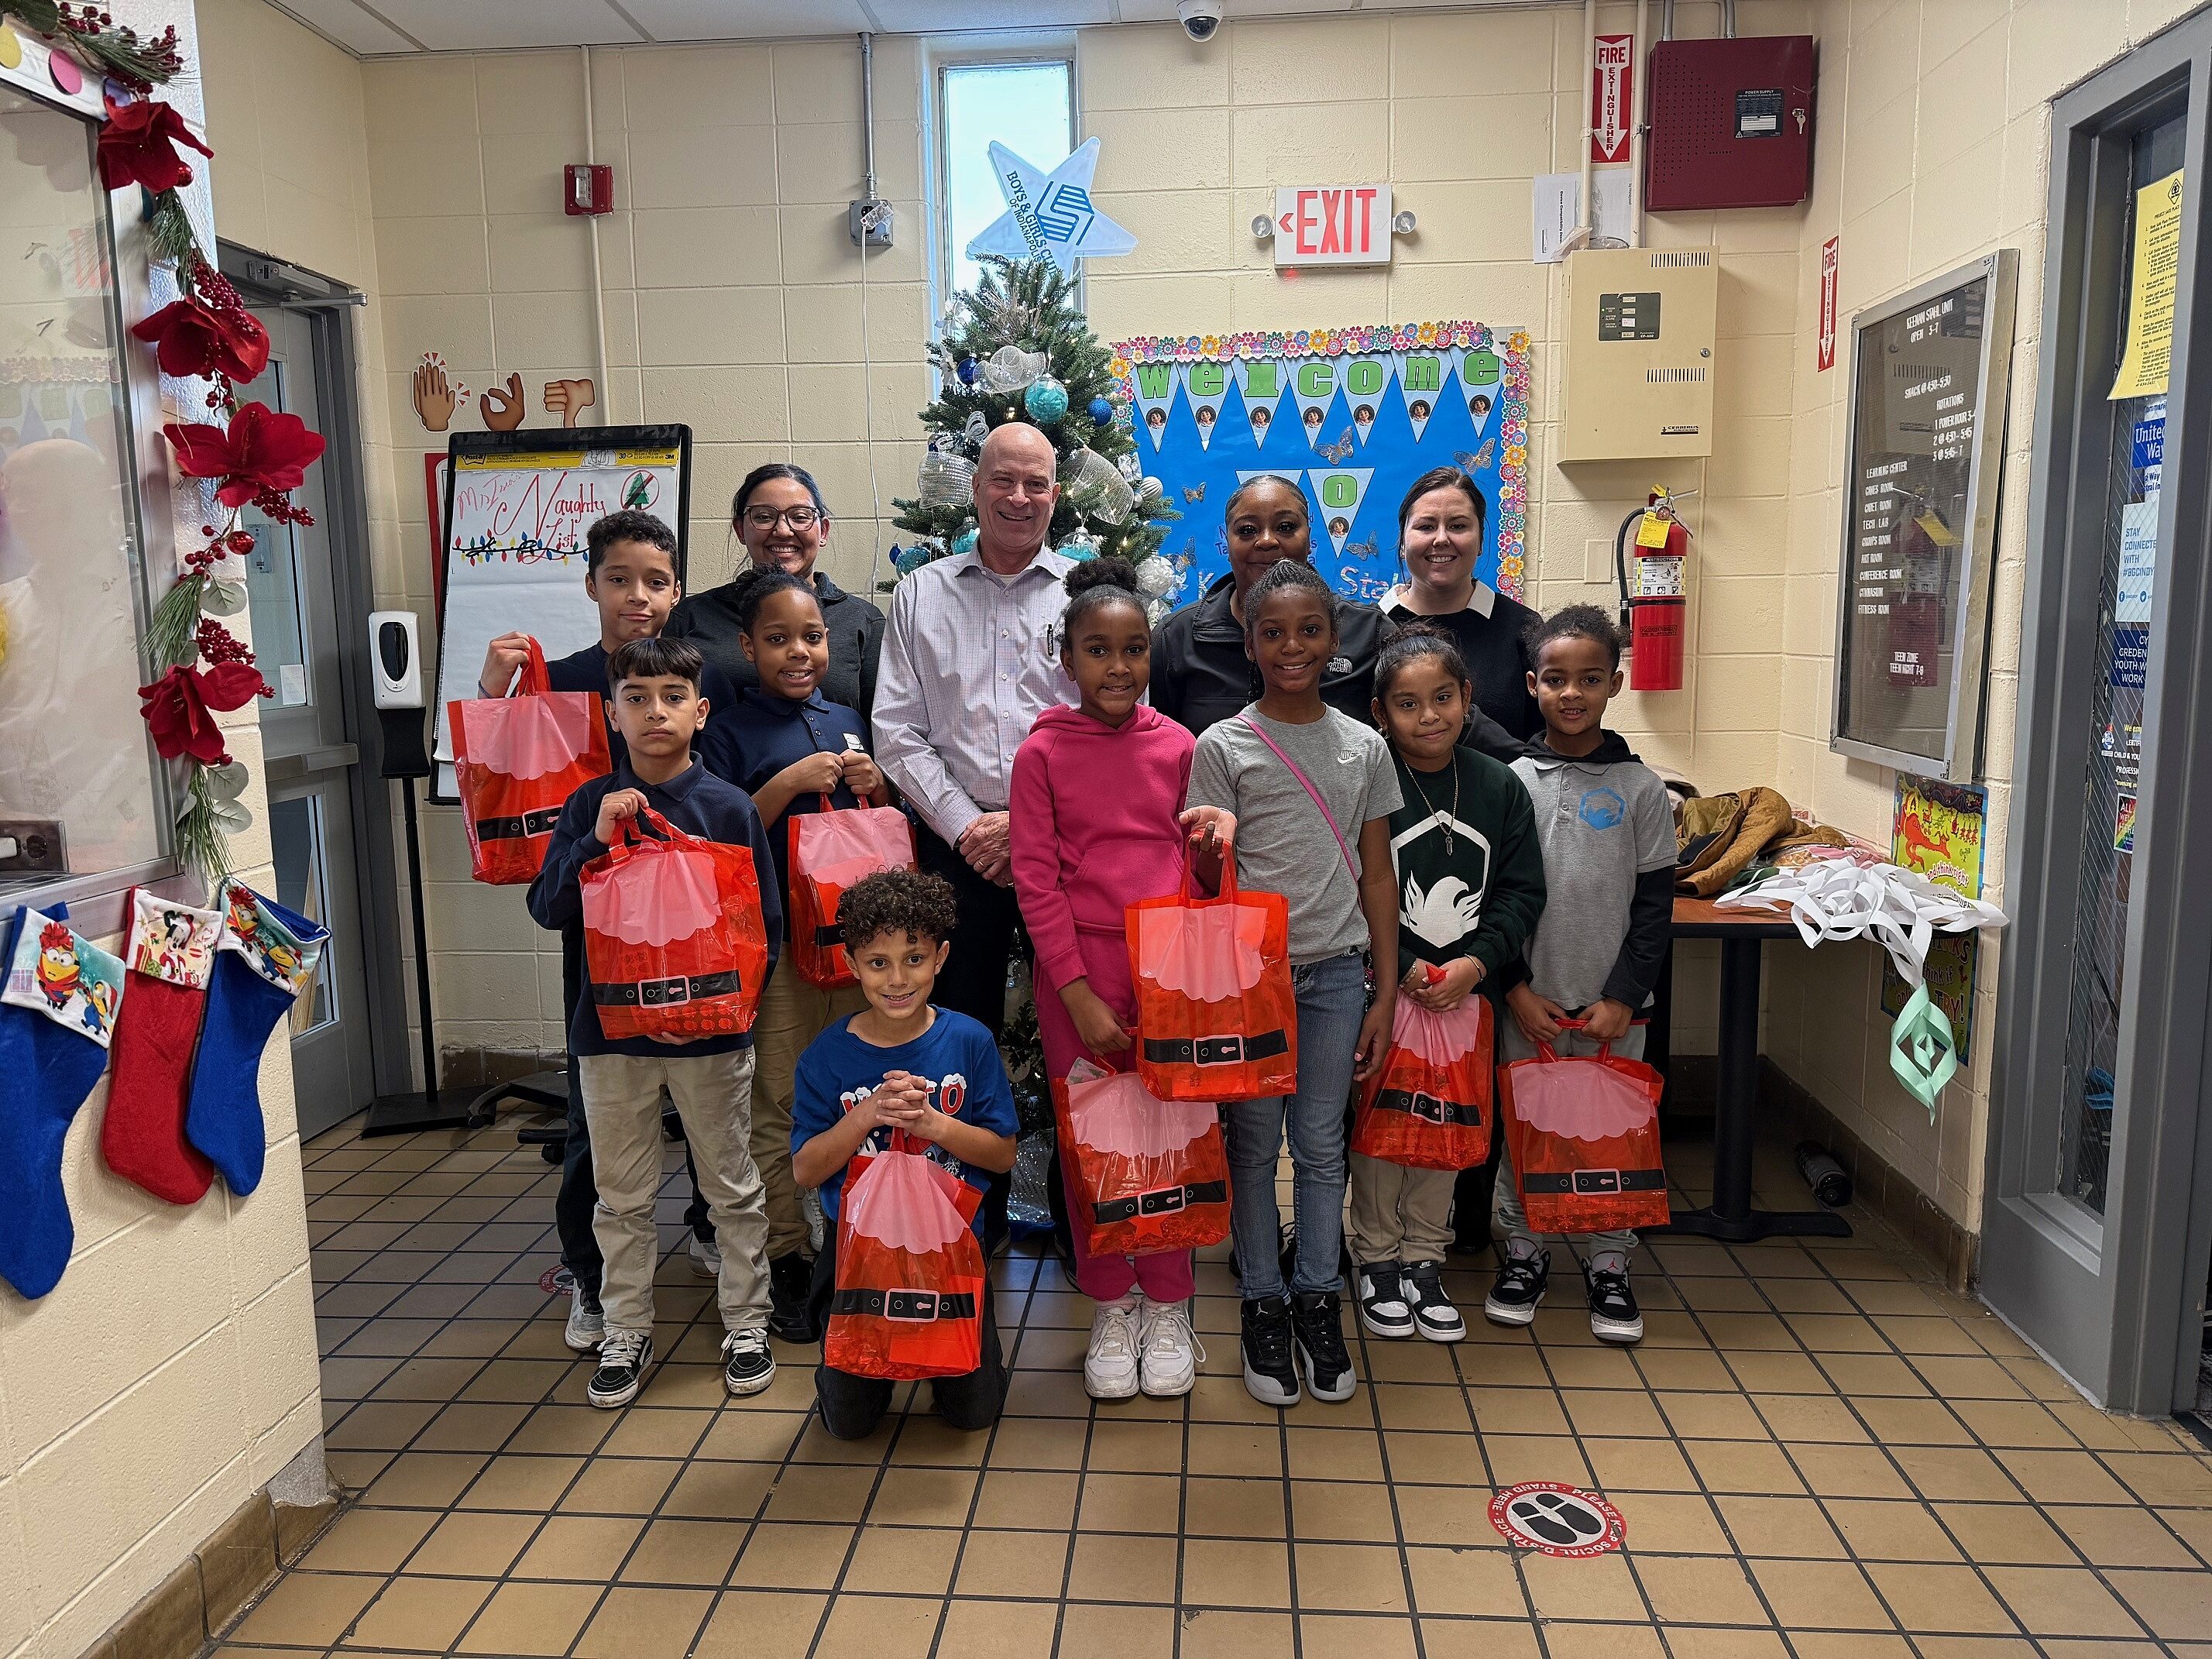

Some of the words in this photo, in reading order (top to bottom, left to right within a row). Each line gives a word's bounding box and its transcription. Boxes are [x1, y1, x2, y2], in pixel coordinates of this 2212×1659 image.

[1599, 46, 1626, 64] FIRE
[1606, 67, 1616, 150] EXTINGUISHER
[1006, 170, 1028, 202] BOYS
[1009, 198, 1020, 210] OF
[1021, 203, 1031, 214] &
[1297, 189, 1376, 254] EXIT
[1014, 209, 1042, 263] INDIANAPOLIS
[1025, 214, 1046, 248] GIRLS
[1825, 249, 1836, 271] FIRE
[1906, 311, 1925, 330] KEENAN
[1925, 304, 1941, 321] STAHL
[1942, 298, 1953, 315] UNIT
[1910, 329, 1923, 343] OPEN
[1929, 322, 1939, 335] 3-7
[1905, 385, 1921, 399] SNACK
[1921, 382, 1926, 394] @
[1936, 393, 1964, 410] ROTATIONS
[1939, 416, 1954, 430] POWER
[1933, 435, 1938, 446] 2
[1890, 461, 1907, 474] CENTER
[1323, 475, 1358, 508] o
[493, 471, 606, 540] Naughty
[1879, 517, 1889, 528] LAB
[2125, 527, 2140, 537] STAY
[517, 519, 577, 565] List
[2124, 555, 2139, 564] WITH
[1860, 569, 1887, 581] CONFERENCE
[2123, 567, 2155, 577] #BGCINDY
[1858, 604, 1877, 614] FITNESS
[1894, 651, 1906, 661] TEEN
[1907, 652, 1918, 663] ZONE
[1890, 663, 1901, 674] TEEN
[2114, 660, 2138, 671] YOUTH
[2121, 673, 2143, 684] WORK
[1340, 750, 1355, 759] NIKE
[2120, 802, 2132, 813] ALL
[1927, 864, 1936, 880] and
[1937, 860, 1953, 876] think
[1953, 867, 1969, 885] right
[1946, 966, 1953, 981] if
[1935, 989, 1966, 1024] TRY!
[1513, 1482, 1558, 1493] STAND
[1492, 1490, 1514, 1511] HERE
[1571, 1488, 1617, 1521] PLEASE
[1493, 1517, 1554, 1554] DSTANCE
[1559, 1541, 1612, 1556] SOCIAL
